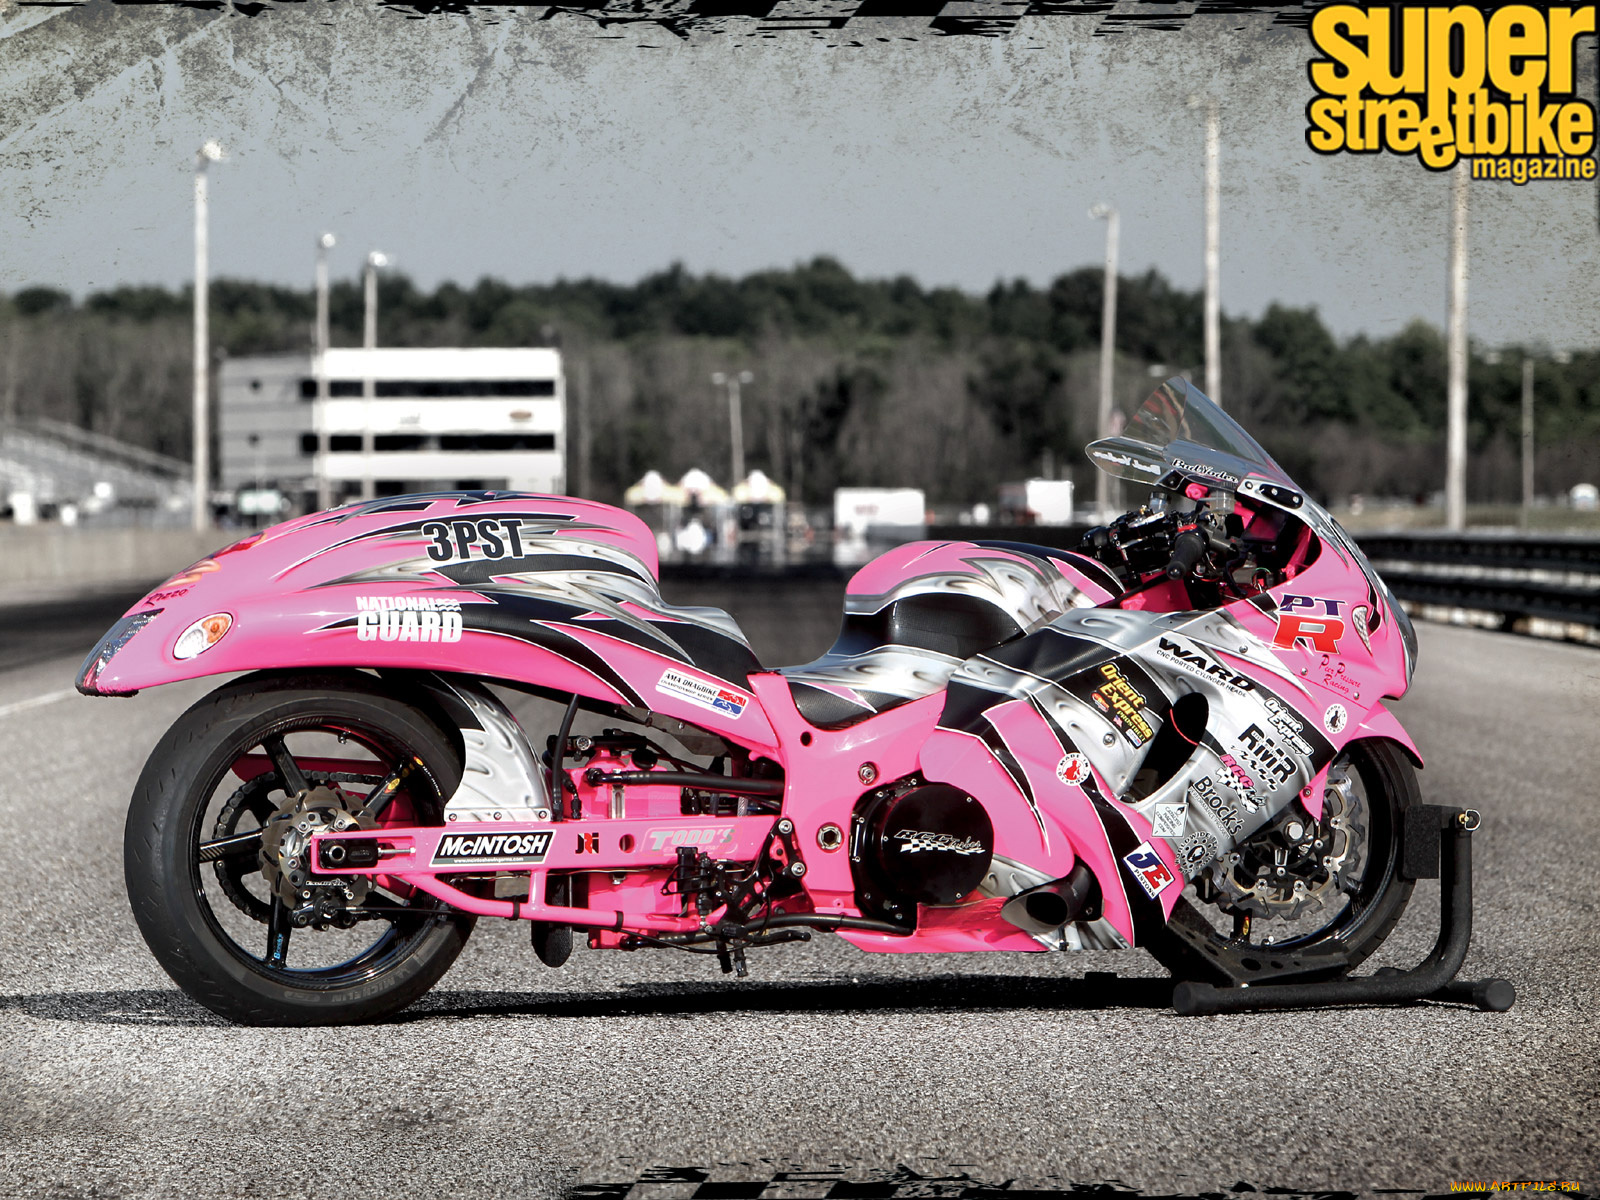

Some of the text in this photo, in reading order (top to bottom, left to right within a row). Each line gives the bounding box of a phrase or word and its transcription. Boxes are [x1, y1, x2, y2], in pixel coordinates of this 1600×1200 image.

[421, 519, 525, 561] 3PST
[356, 596, 438, 611] NATIONAL
[357, 610, 463, 643] GUARD
[1272, 615, 1346, 654] R
[1159, 637, 1256, 692] WARD
[1170, 656, 1195, 672] PORTED
[1100, 663, 1145, 708] Orient
[1099, 682, 1154, 739] Express
[1193, 775, 1245, 835] Brock's
[440, 834, 549, 856] McINTOSH
[649, 828, 736, 852] TODD'S
[1126, 851, 1172, 890] JE
[1133, 868, 1156, 897] PISTONS
[331, 975, 396, 1003] MICHELIN
